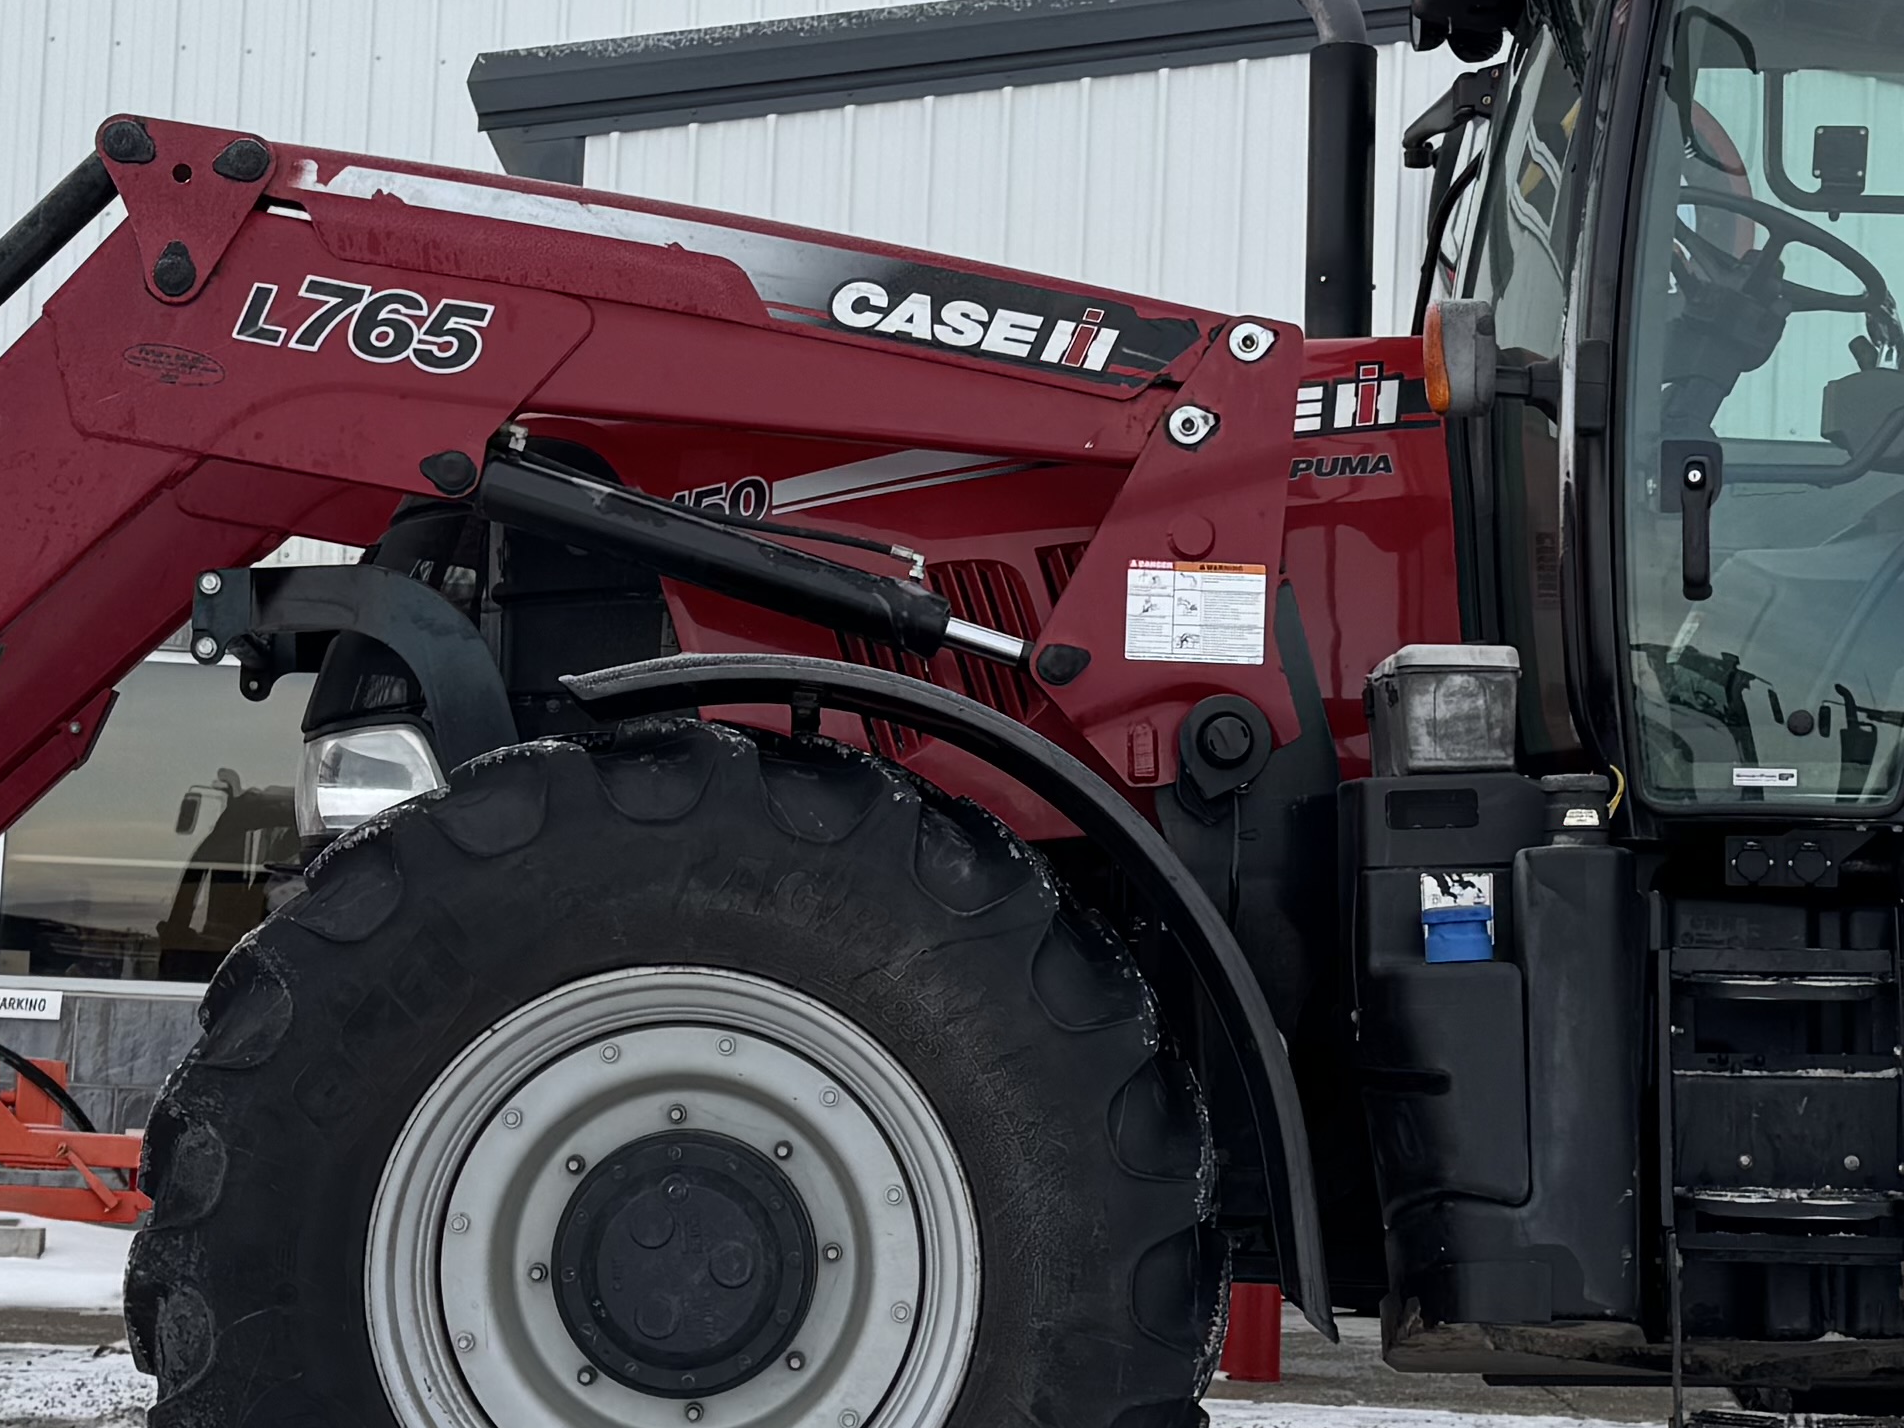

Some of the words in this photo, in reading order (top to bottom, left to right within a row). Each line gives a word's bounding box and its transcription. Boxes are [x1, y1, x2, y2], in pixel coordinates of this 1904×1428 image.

[232, 275, 495, 374] L765
[832, 281, 1044, 358] CASE
[1289, 453, 1394, 480] PUMA
